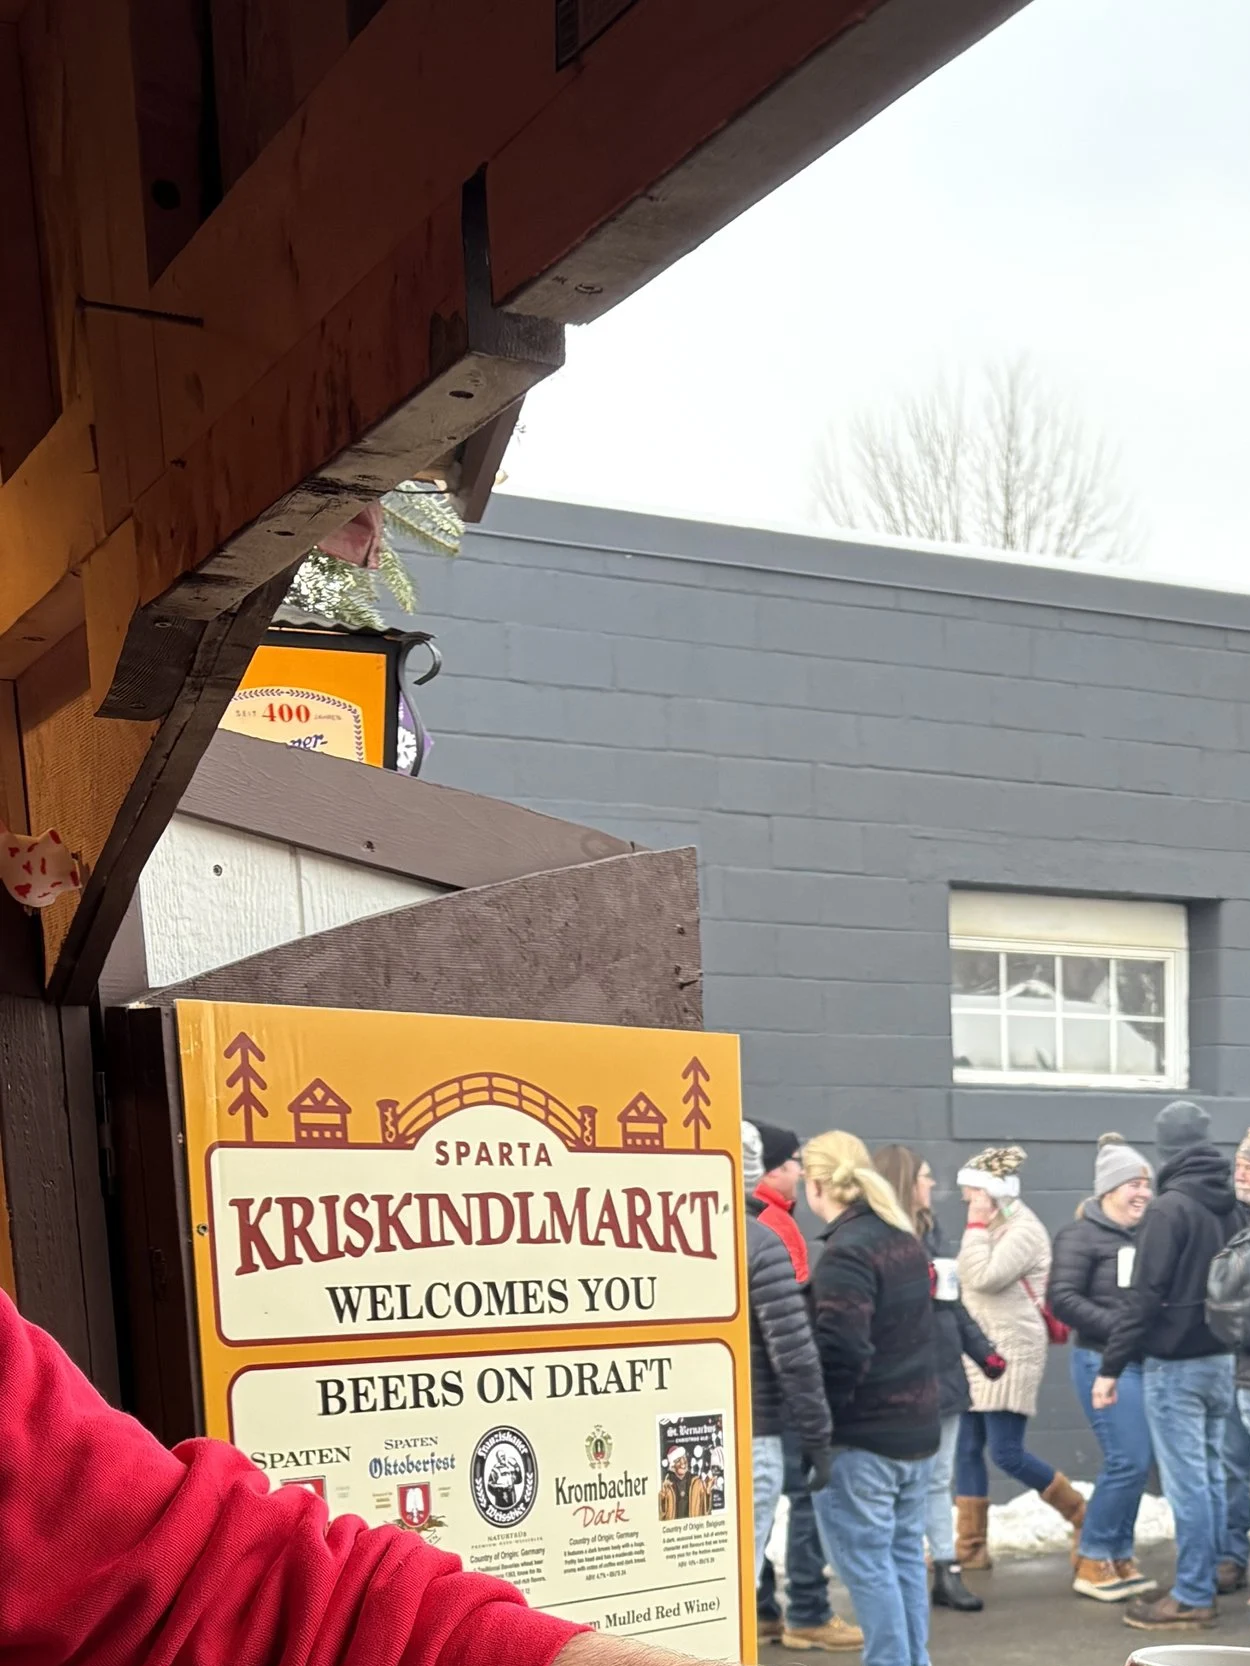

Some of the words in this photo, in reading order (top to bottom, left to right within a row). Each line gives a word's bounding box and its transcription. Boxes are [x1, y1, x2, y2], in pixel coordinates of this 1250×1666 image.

[262, 703, 311, 724] 400
[435, 1139, 553, 1167] SPARTA
[228, 1186, 720, 1277] KRISKINDLMARKT
[325, 1278, 569, 1323] WELCOMES
[578, 1276, 658, 1312] YOU
[316, 1369, 465, 1417] BEERS
[477, 1365, 535, 1404] ON
[545, 1357, 673, 1399] DRAFT
[384, 1436, 440, 1451] SPATEN
[250, 1446, 352, 1471] SPATEN
[368, 1451, 457, 1479] Oktoberfest
[554, 1470, 649, 1506] Krombacher
[572, 1501, 631, 1529] Dark
[569, 1537, 591, 1547] Country
[591, 1535, 597, 1543] of
[470, 1553, 493, 1564] Country
[494, 1553, 500, 1561] of
[520, 1547, 546, 1559] Germany
[605, 1607, 652, 1629] Mulled
[655, 1602, 682, 1621] Red
[684, 1597, 721, 1615] Wine)
